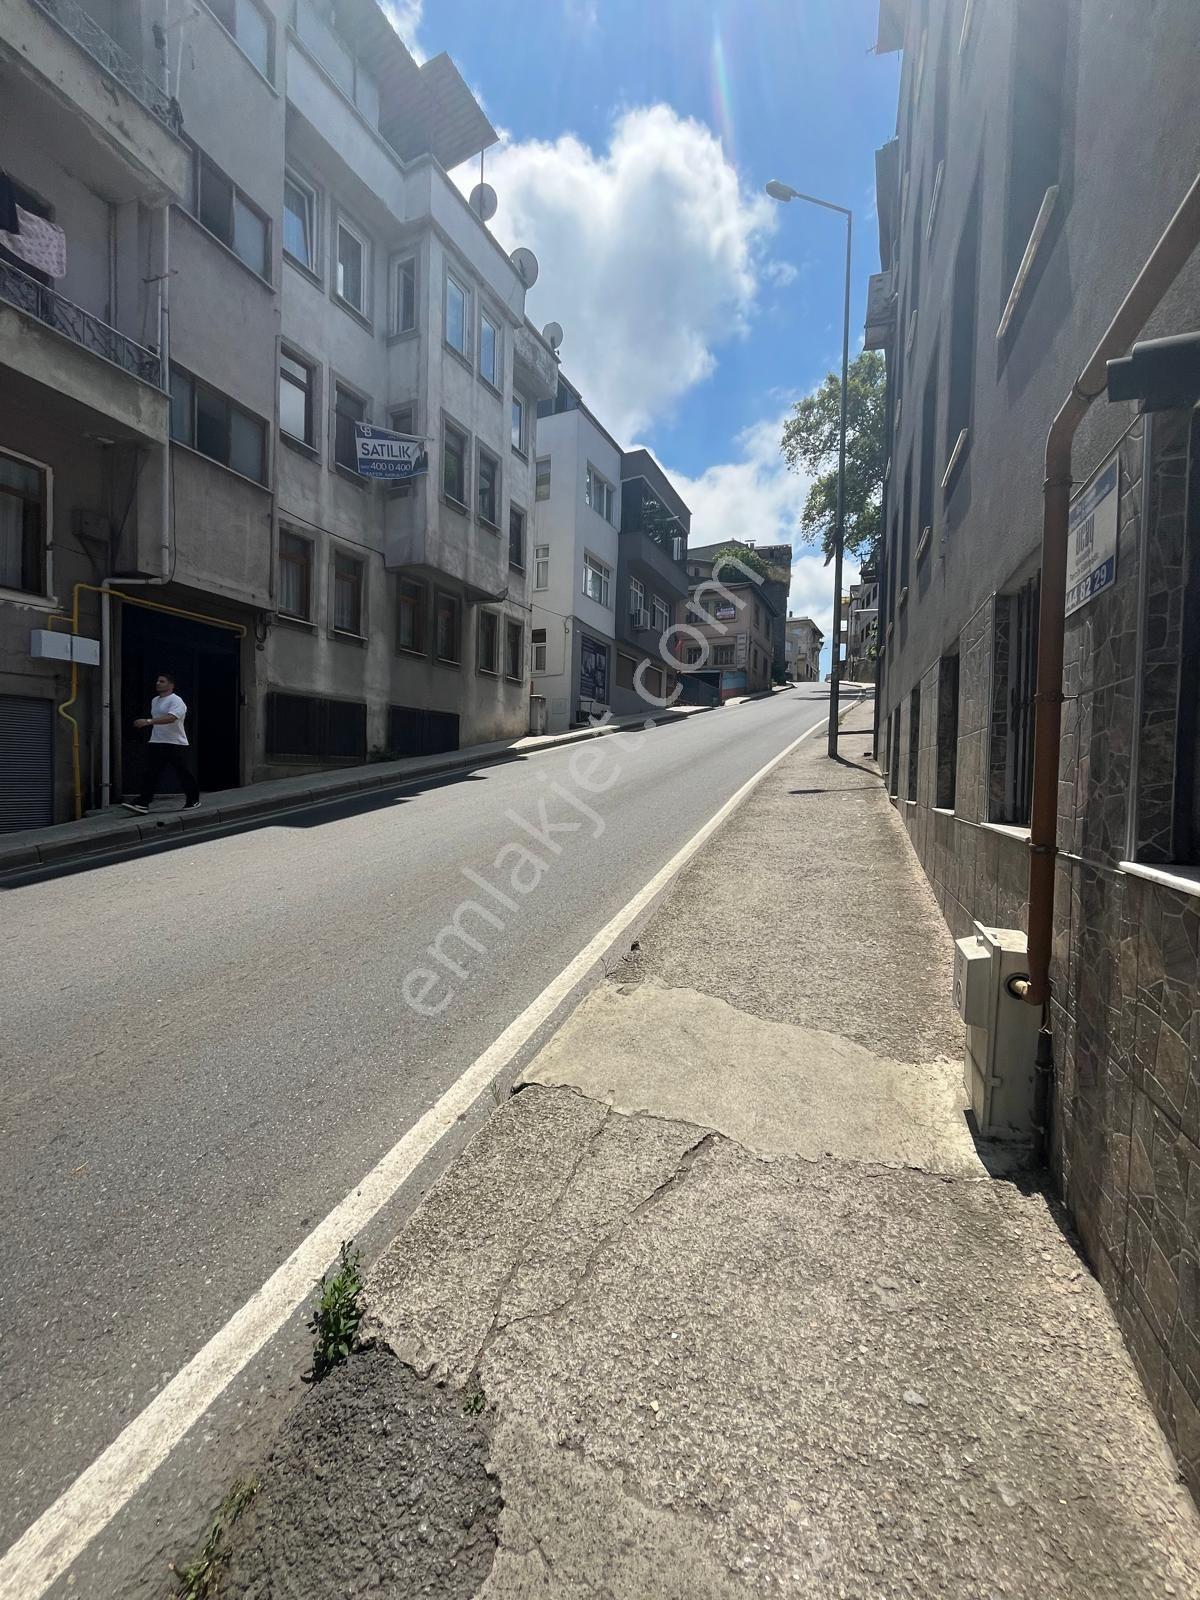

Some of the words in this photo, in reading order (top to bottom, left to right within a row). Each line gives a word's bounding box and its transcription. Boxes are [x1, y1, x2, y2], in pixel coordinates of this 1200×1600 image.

[361, 443, 411, 458] SATILIK
[370, 462, 387, 471] 400
[395, 463, 411, 472] 400
[1080, 577, 1091, 601] 82
[1094, 565, 1107, 592] 29
